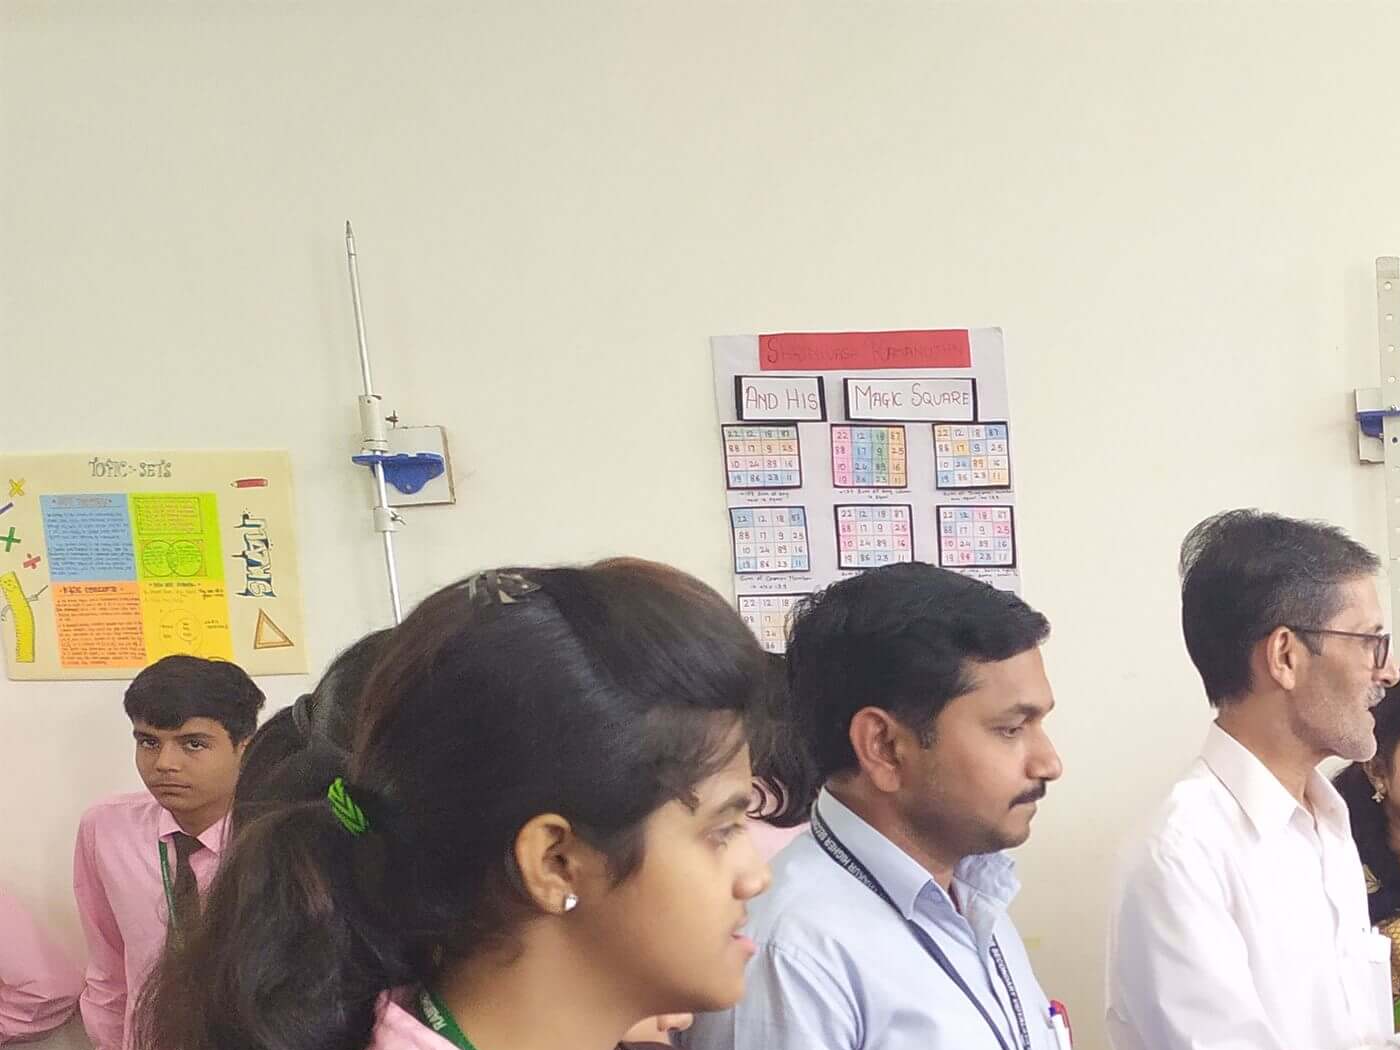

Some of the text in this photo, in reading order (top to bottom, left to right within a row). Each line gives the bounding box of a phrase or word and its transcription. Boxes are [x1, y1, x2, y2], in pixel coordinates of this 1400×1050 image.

[746, 385, 818, 410] AND HIS
[855, 382, 969, 411] MAGIC SQUARE
[139, 460, 172, 478] SETS
